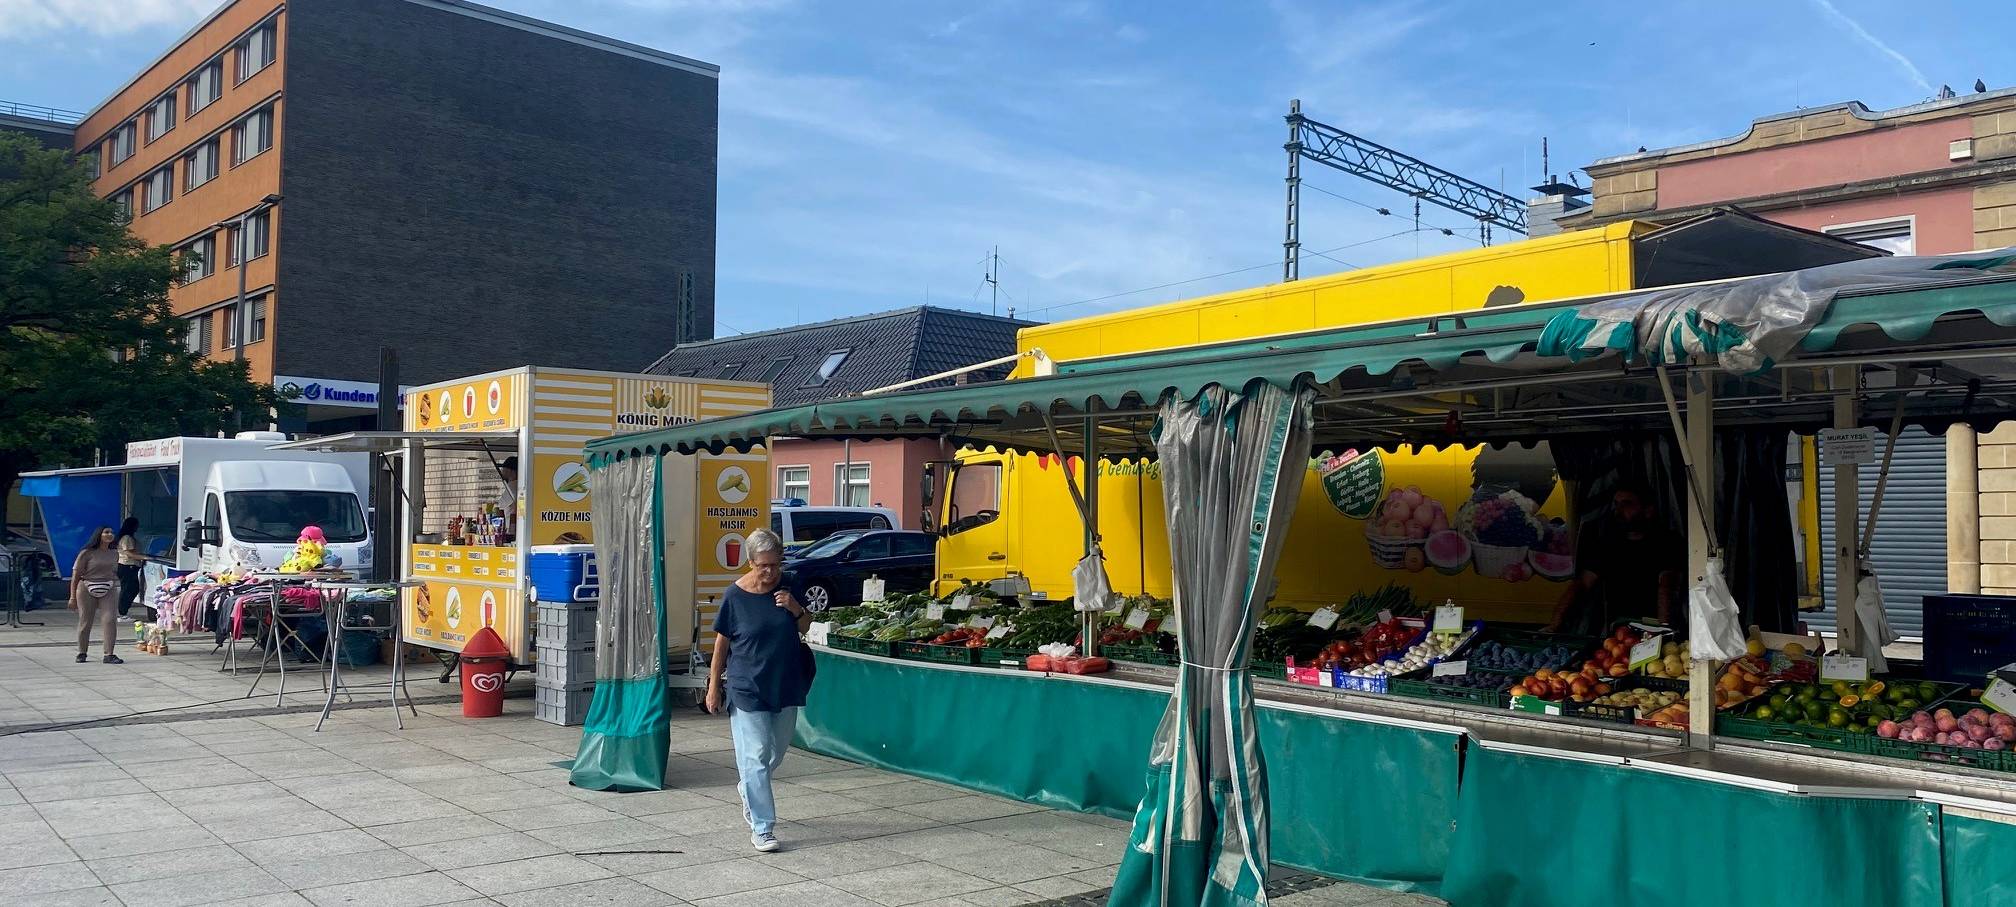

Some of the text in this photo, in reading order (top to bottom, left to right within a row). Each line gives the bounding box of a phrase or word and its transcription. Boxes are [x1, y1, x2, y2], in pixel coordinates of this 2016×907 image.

[324, 387, 375, 402] Kunden
[541, 510, 591, 522] KÖZDE MIS
[720, 520, 746, 529] MISIR
